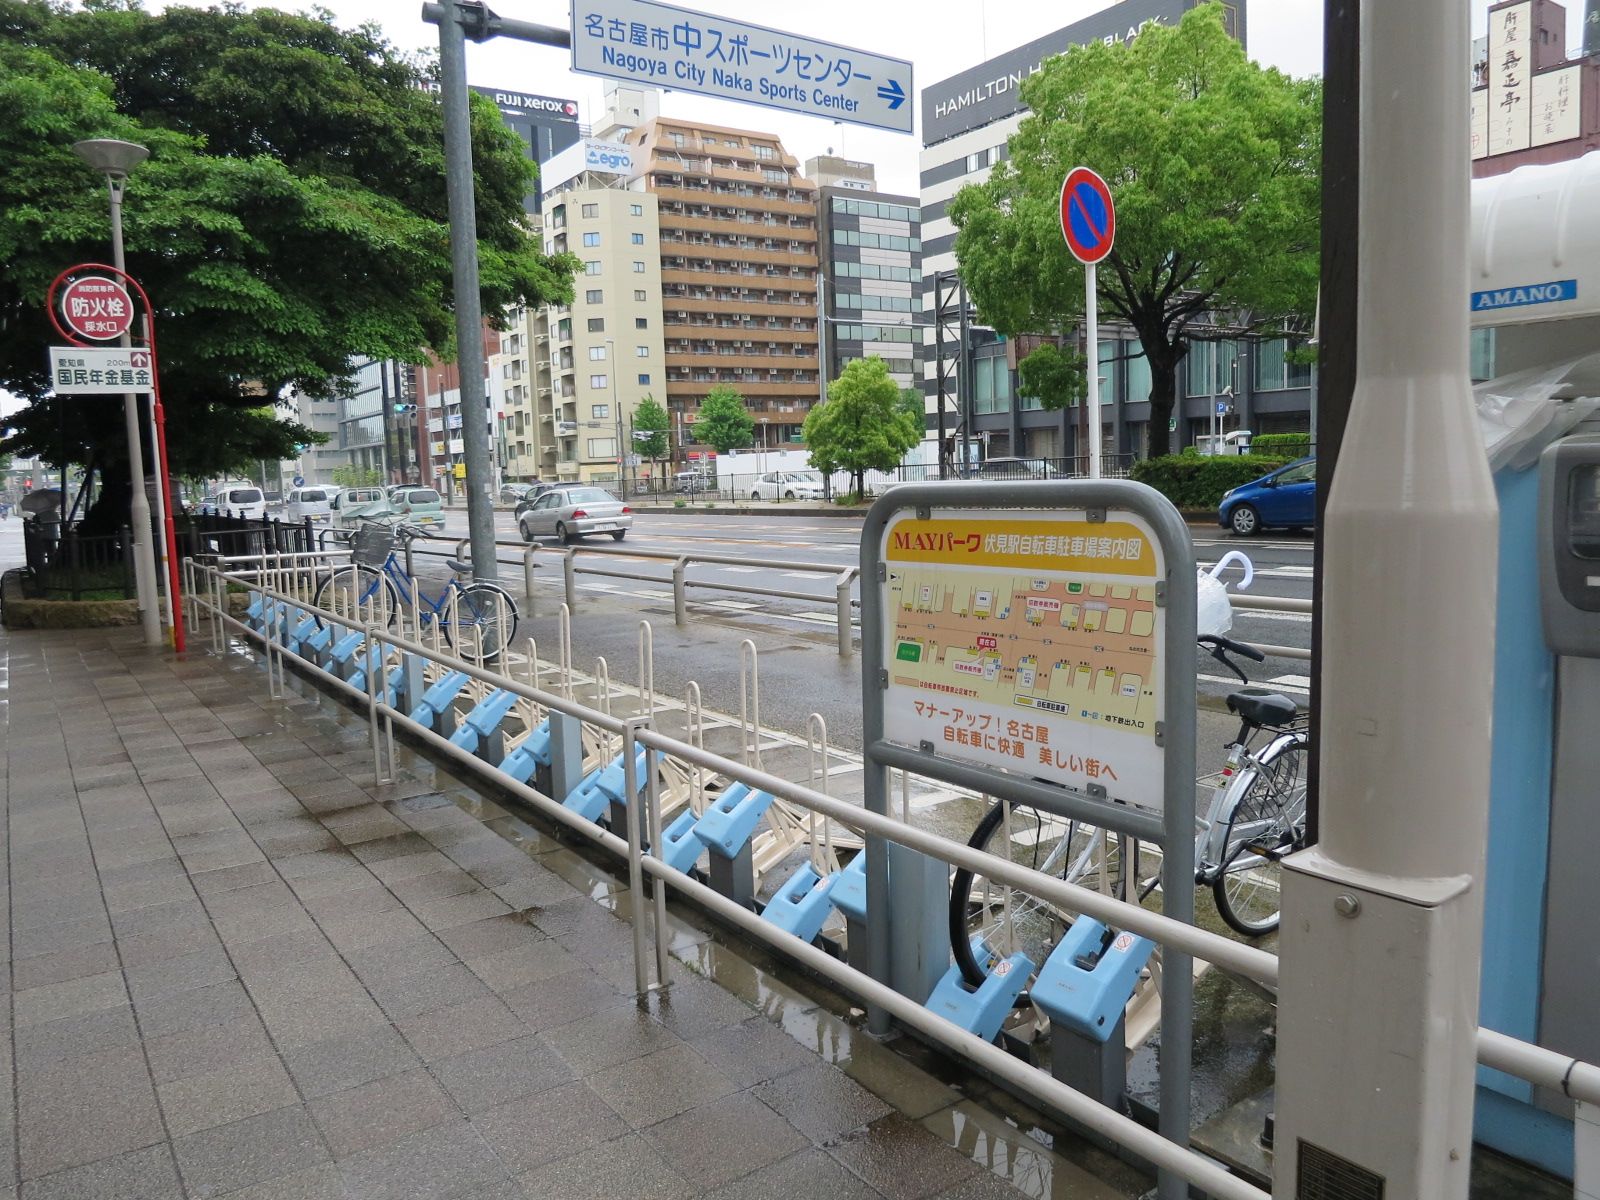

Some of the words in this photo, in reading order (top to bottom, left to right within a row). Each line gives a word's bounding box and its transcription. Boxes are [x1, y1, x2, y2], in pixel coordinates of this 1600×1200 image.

[585, 12, 872, 88] 名古屋市中スポーツセンター
[602, 45, 668, 76] Nagoya
[674, 60, 706, 86] City
[712, 69, 753, 93] Naka
[758, 78, 807, 103] Sports
[812, 88, 859, 114] Center
[495, 92, 521, 107] FUJI
[523, 96, 564, 112] xerox
[935, 70, 1022, 120] HAMILTON
[71, 297, 125, 317] 防火栓
[1477, 284, 1563, 308] AMANO
[57, 369, 150, 386] 国民年金基金
[1218, 403, 1224, 411] P
[894, 531, 982, 553] MAYパーク
[984, 534, 1142, 561] 伏見駅自転車駐車場案内図
[943, 727, 1025, 759] 自転車に快適
[1038, 749, 1118, 782] 美しい街へ
